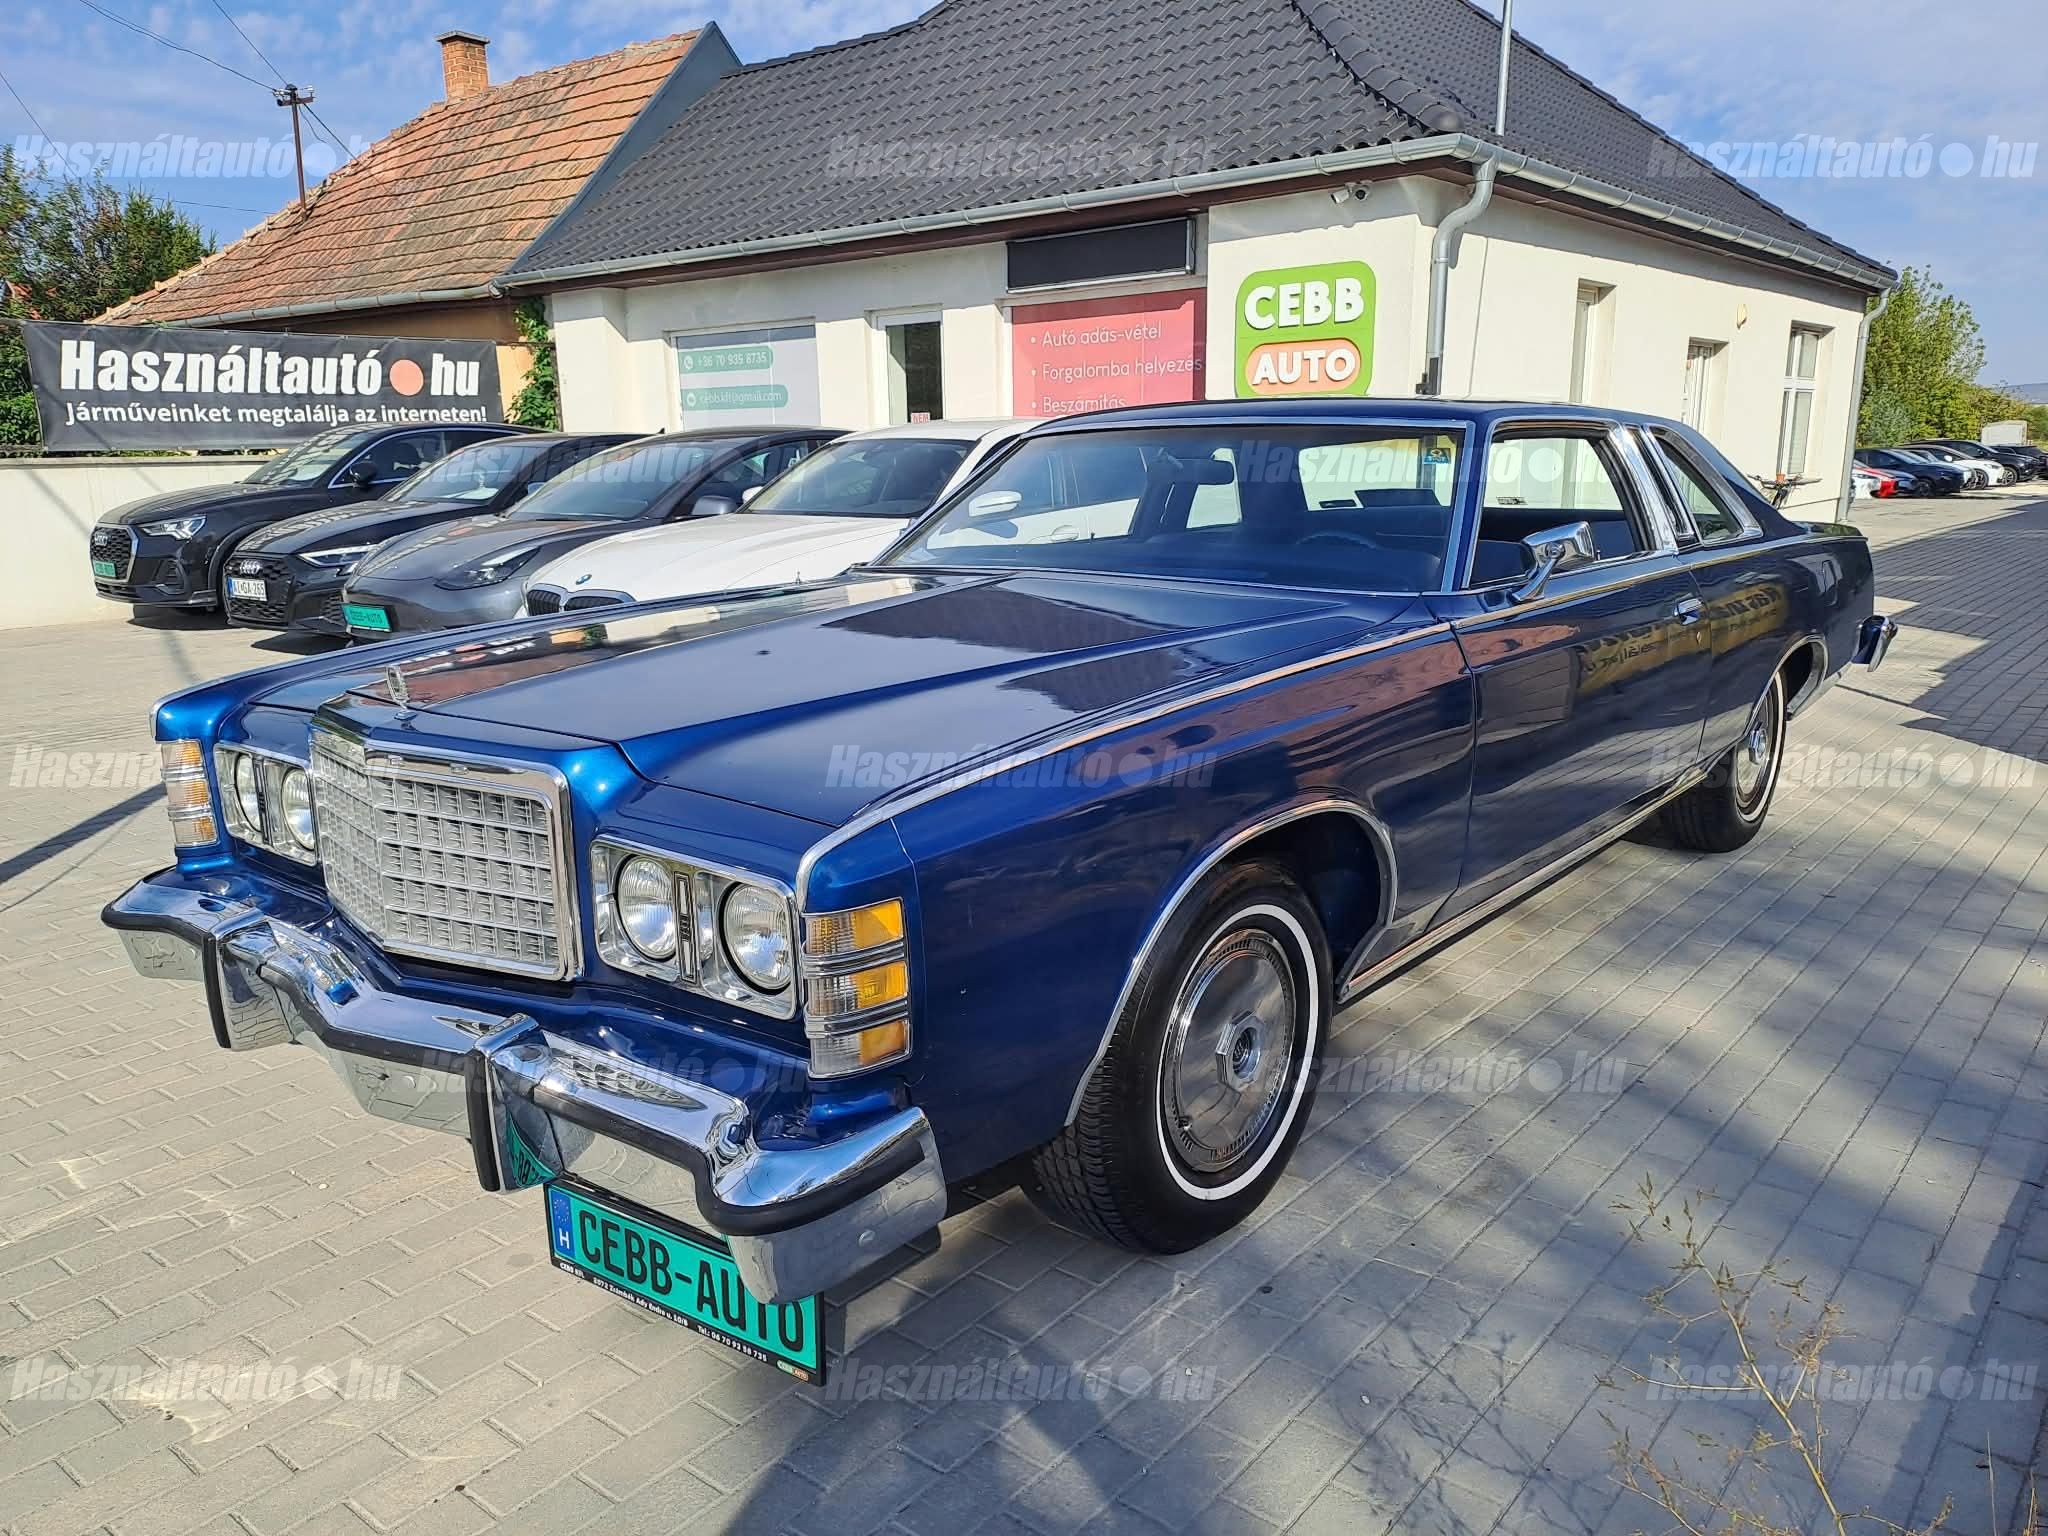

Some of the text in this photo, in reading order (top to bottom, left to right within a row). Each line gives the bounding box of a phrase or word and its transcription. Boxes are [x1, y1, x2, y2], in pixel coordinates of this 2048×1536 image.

[1245, 278, 1364, 330] CEBB
[1043, 321, 1162, 347] Autó adás-vétel
[61, 339, 480, 396] Használtautó hu
[1043, 353, 1202, 383] Forgalomba helyezés
[1252, 349, 1356, 385] AUTO
[65, 402, 487, 427] Járműveinket megtalálja az interneten!
[558, 1230, 571, 1250] H
